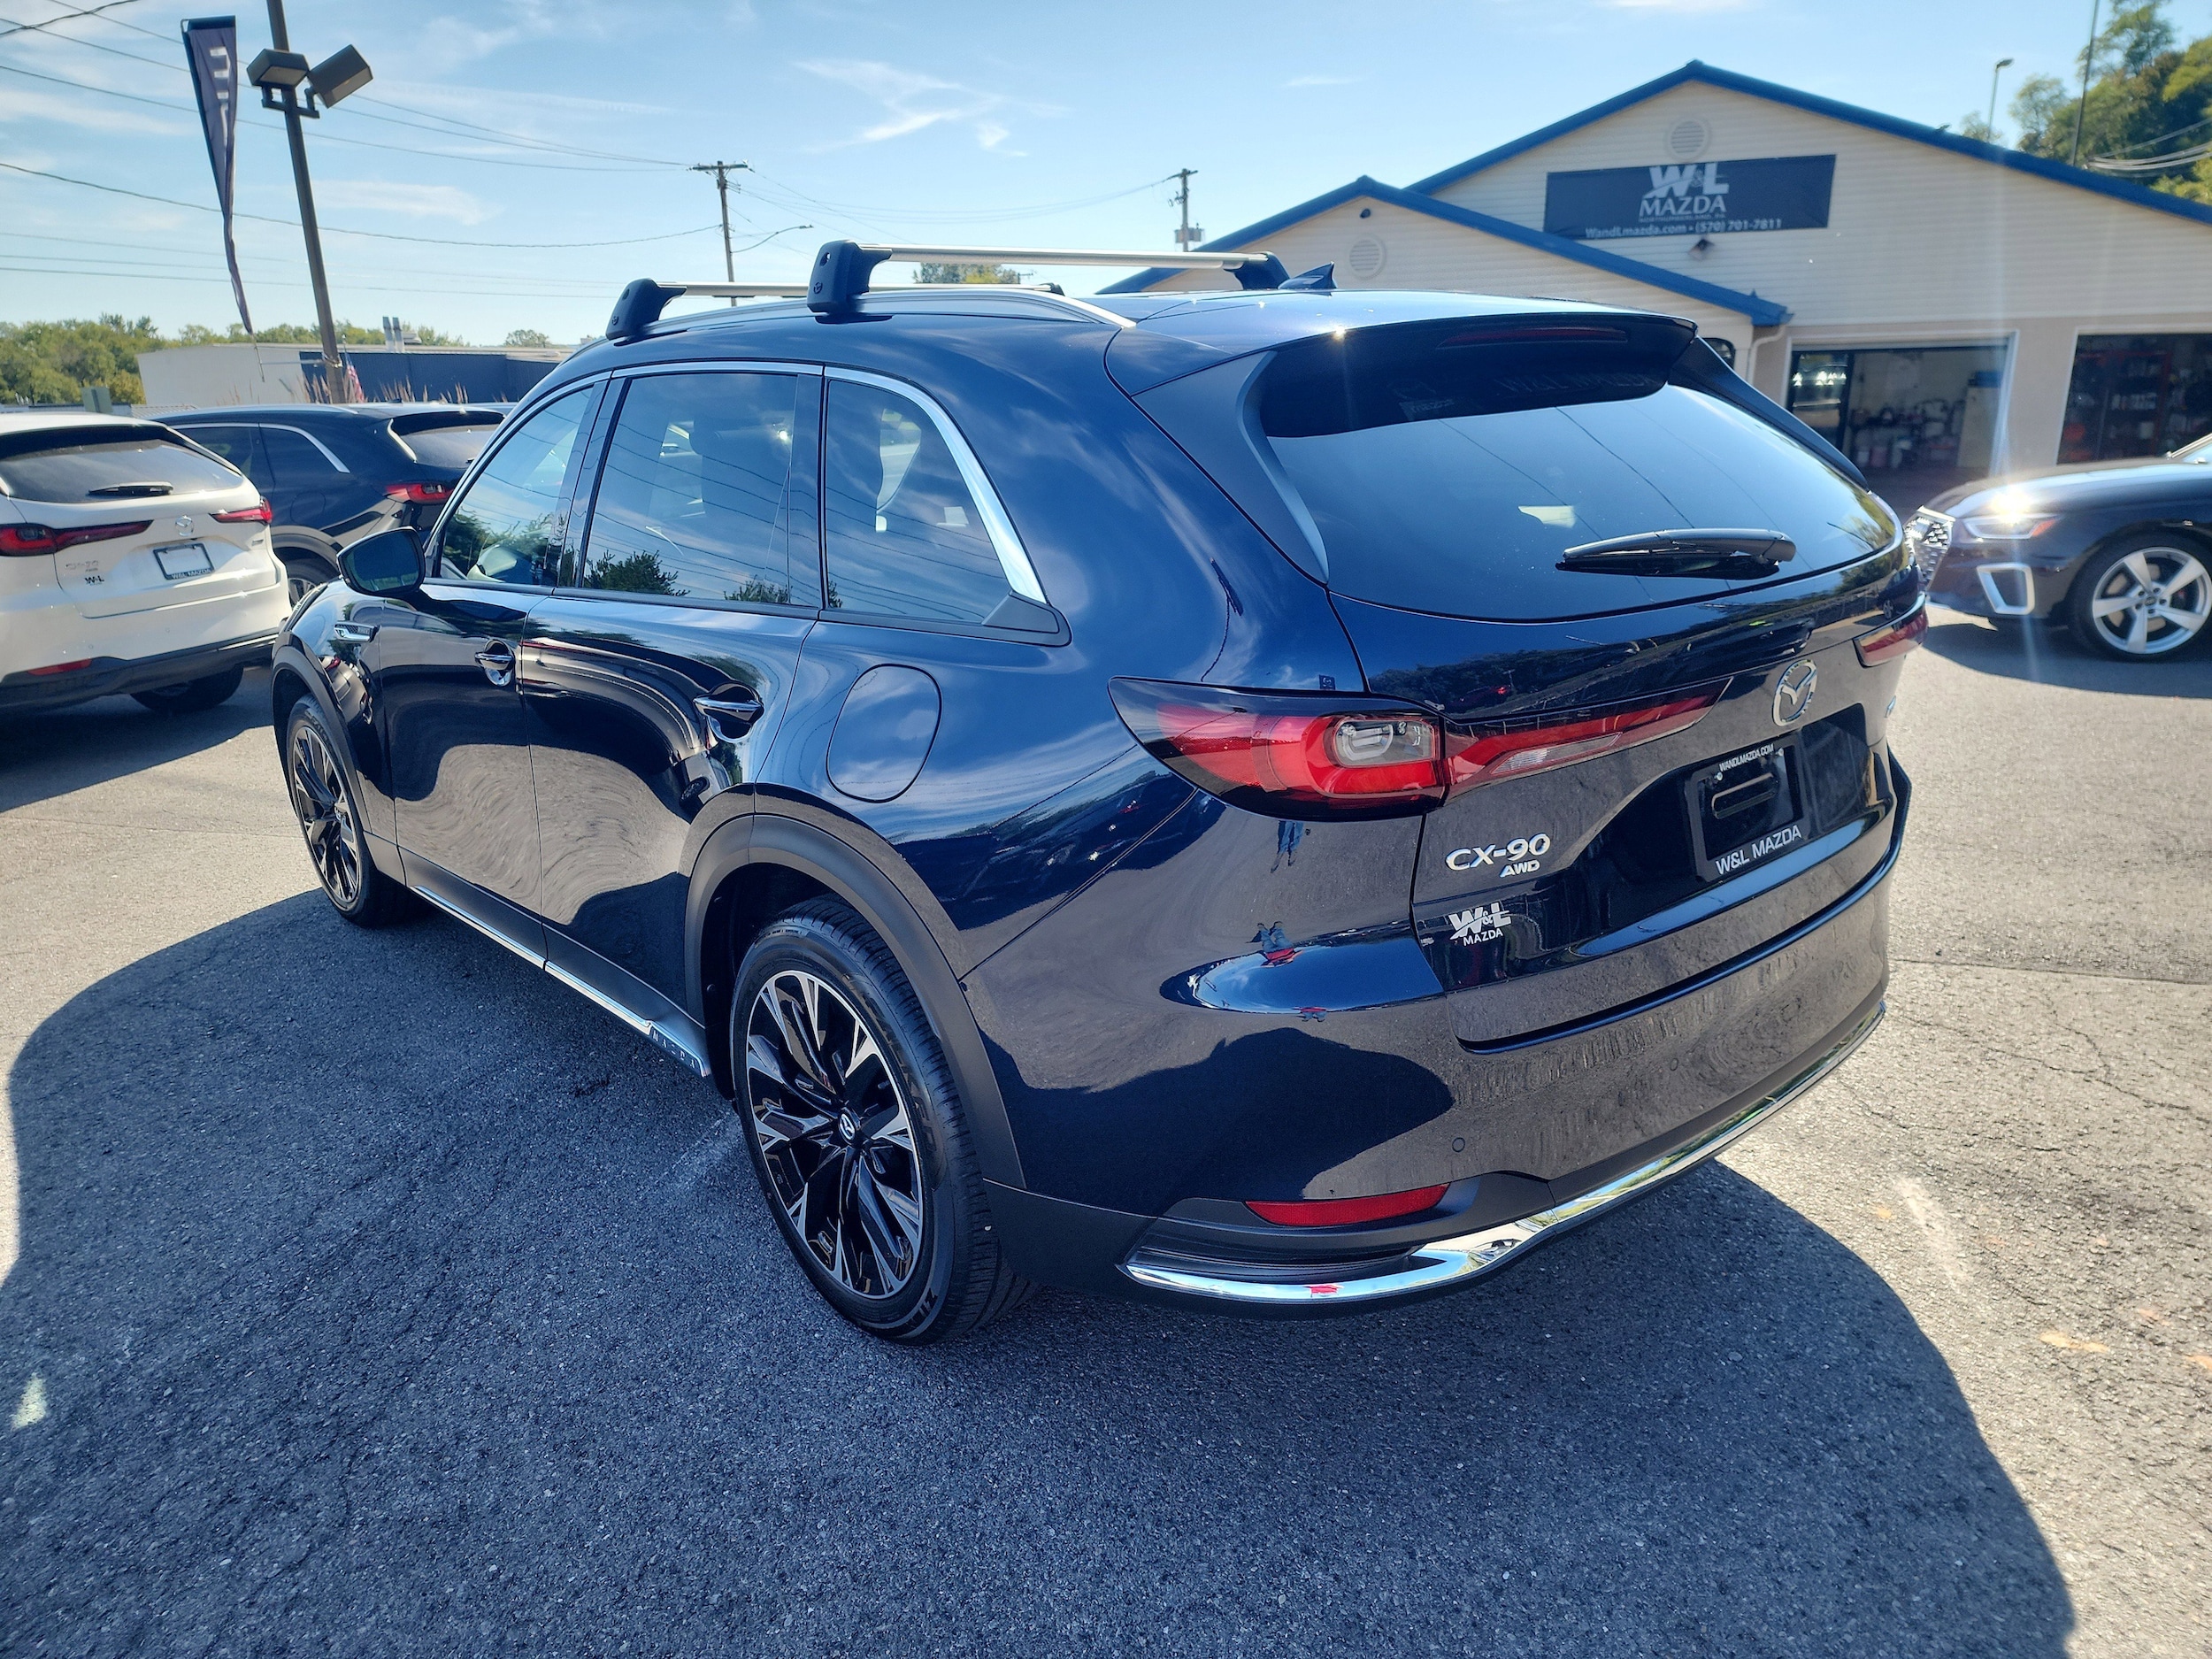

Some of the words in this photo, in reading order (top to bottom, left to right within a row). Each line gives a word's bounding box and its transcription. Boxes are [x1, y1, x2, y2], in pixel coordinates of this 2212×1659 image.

[1643, 163, 1730, 198] W&L
[1640, 195, 1727, 218] MAZDA
[1694, 220, 1725, 234] (570)
[1718, 743, 1774, 772] WANDLMAZDA.COM
[1446, 833, 1551, 871] CX-90
[1715, 849, 1750, 874] W&L
[1751, 825, 1802, 859] MAZDA
[1500, 859, 1540, 878] AWD
[1448, 902, 1512, 940] W&L
[1463, 927, 1503, 947] MAZDA
